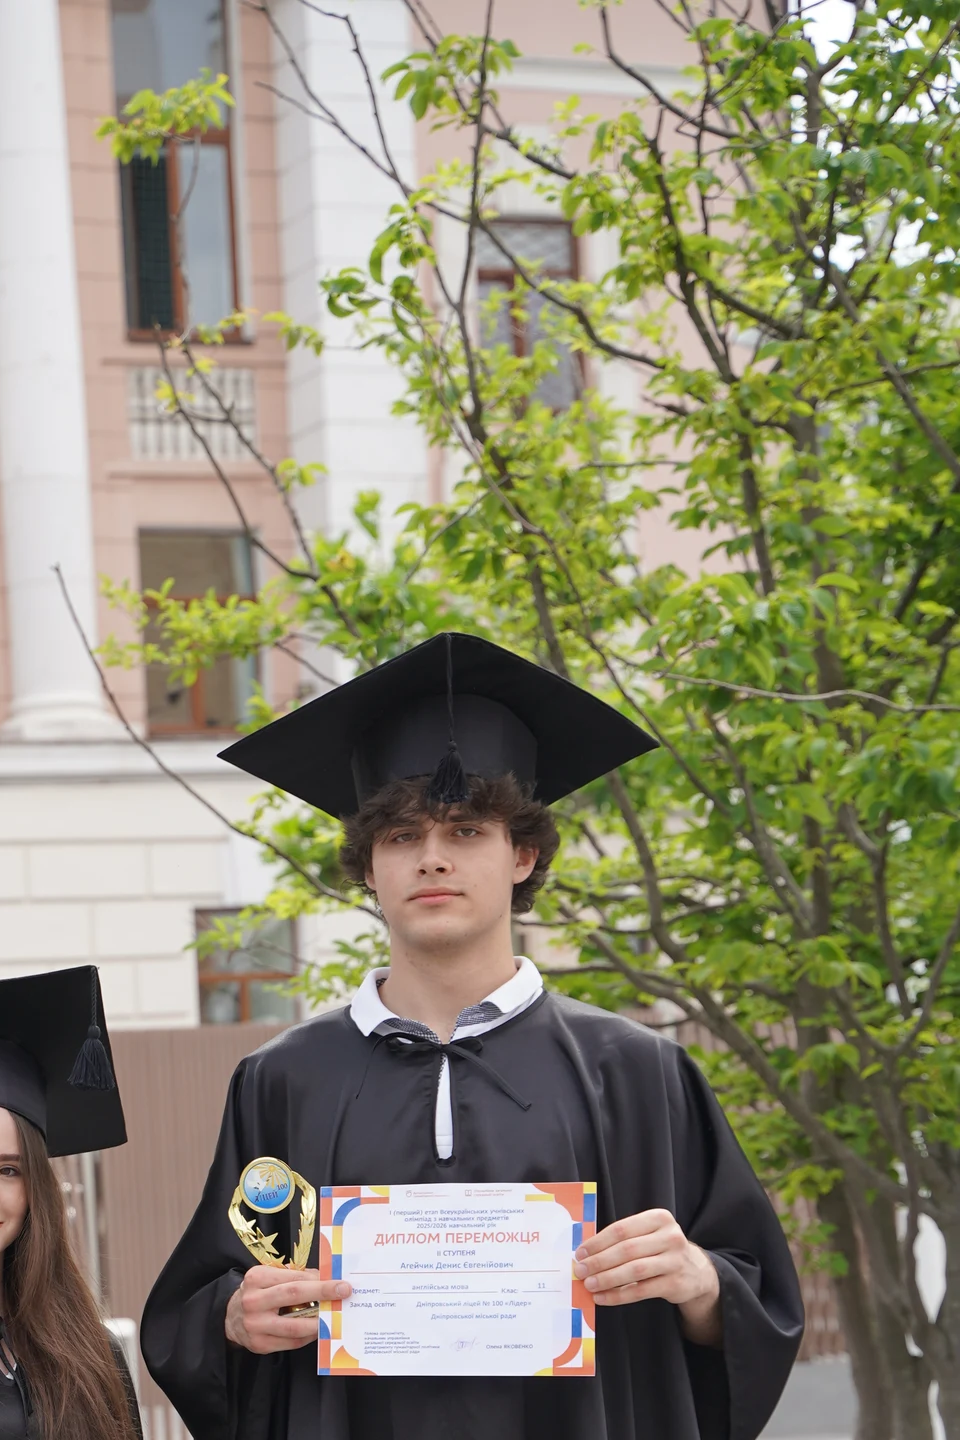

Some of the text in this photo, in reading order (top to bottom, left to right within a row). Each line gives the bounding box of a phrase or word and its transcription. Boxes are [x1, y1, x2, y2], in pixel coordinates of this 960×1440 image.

[374, 1232, 540, 1246] ДИПЛОМ ПЕРЕМОЖЦЯ
[436, 1261, 461, 1270] Денис
[464, 1261, 514, 1269] Євгенійович
